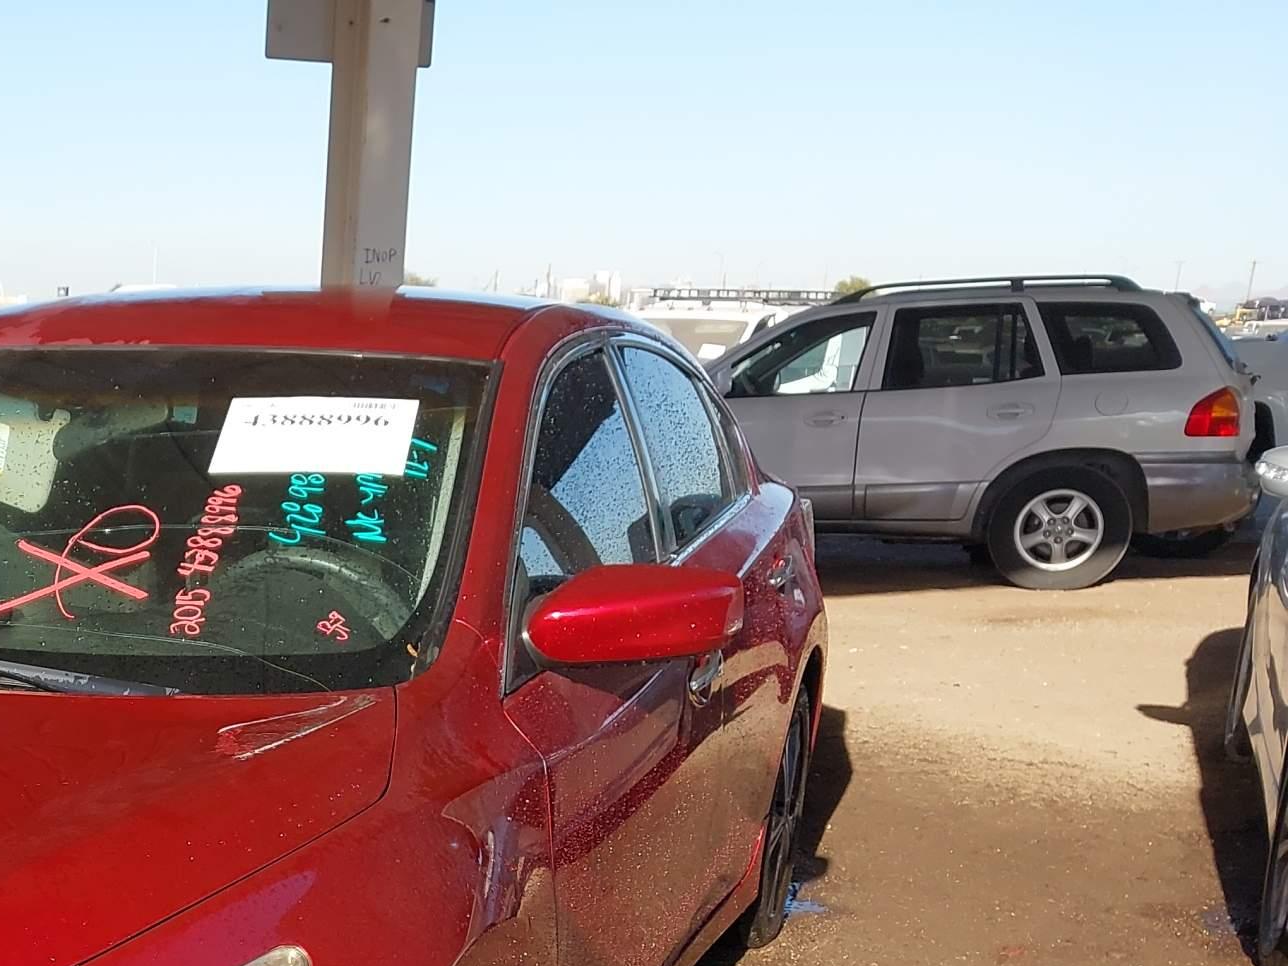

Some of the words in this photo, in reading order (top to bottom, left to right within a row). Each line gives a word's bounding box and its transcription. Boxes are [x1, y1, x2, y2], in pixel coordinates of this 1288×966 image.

[363, 247, 398, 264] INOP
[176, 483, 243, 577] 43888996
[169, 587, 212, 636] 2015
